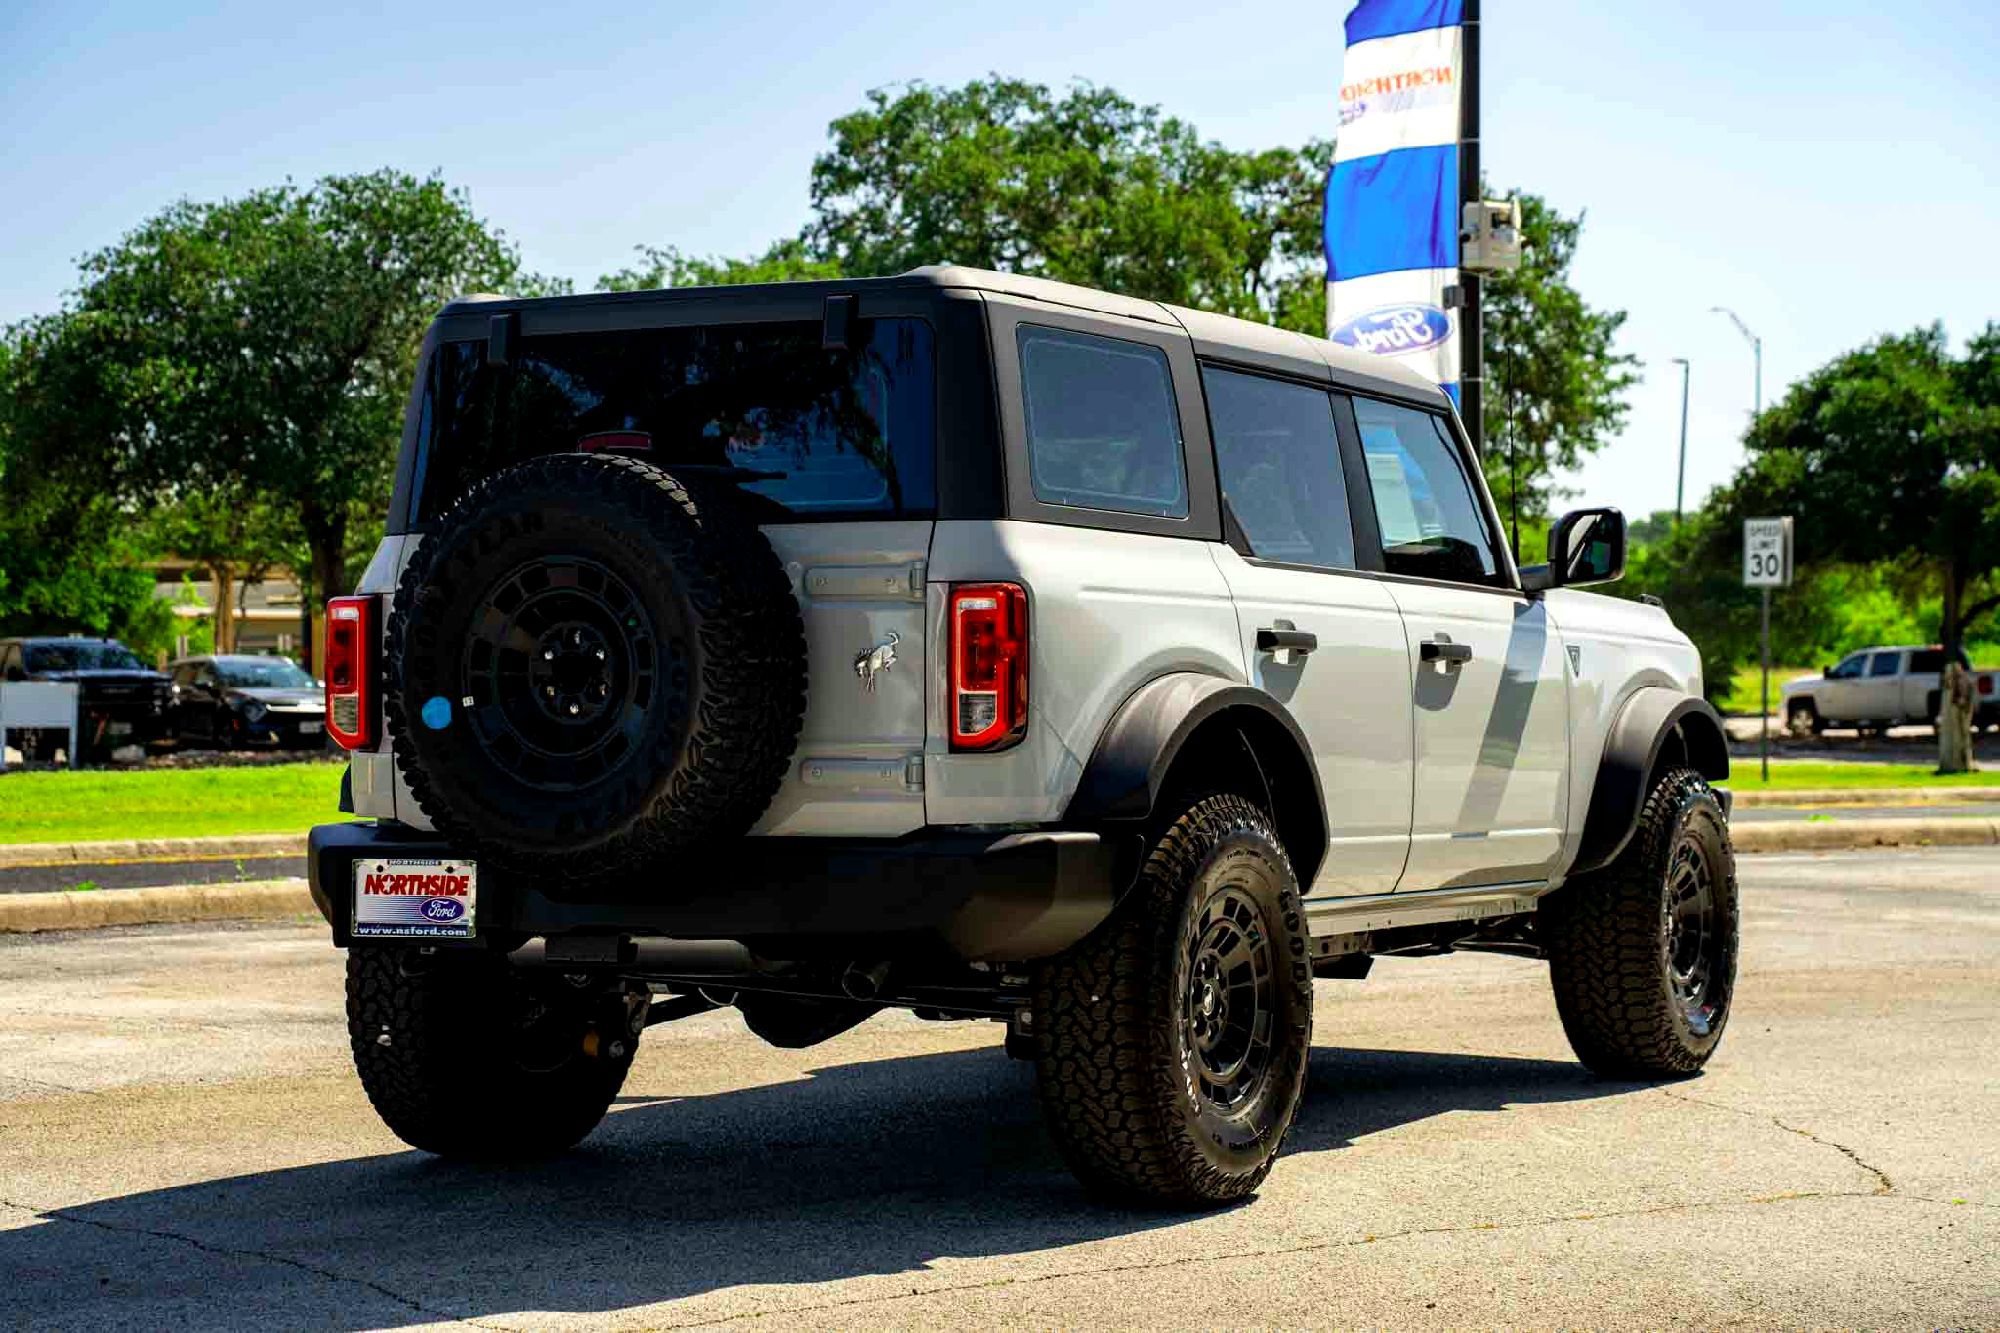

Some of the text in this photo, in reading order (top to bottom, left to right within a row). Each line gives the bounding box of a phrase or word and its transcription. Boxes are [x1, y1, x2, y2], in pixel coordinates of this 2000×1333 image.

[1750, 554, 1779, 577] 30
[364, 874, 470, 896] NORTHSIDE
[428, 899, 456, 918] Ford
[358, 926, 468, 937] www.nsford.com
